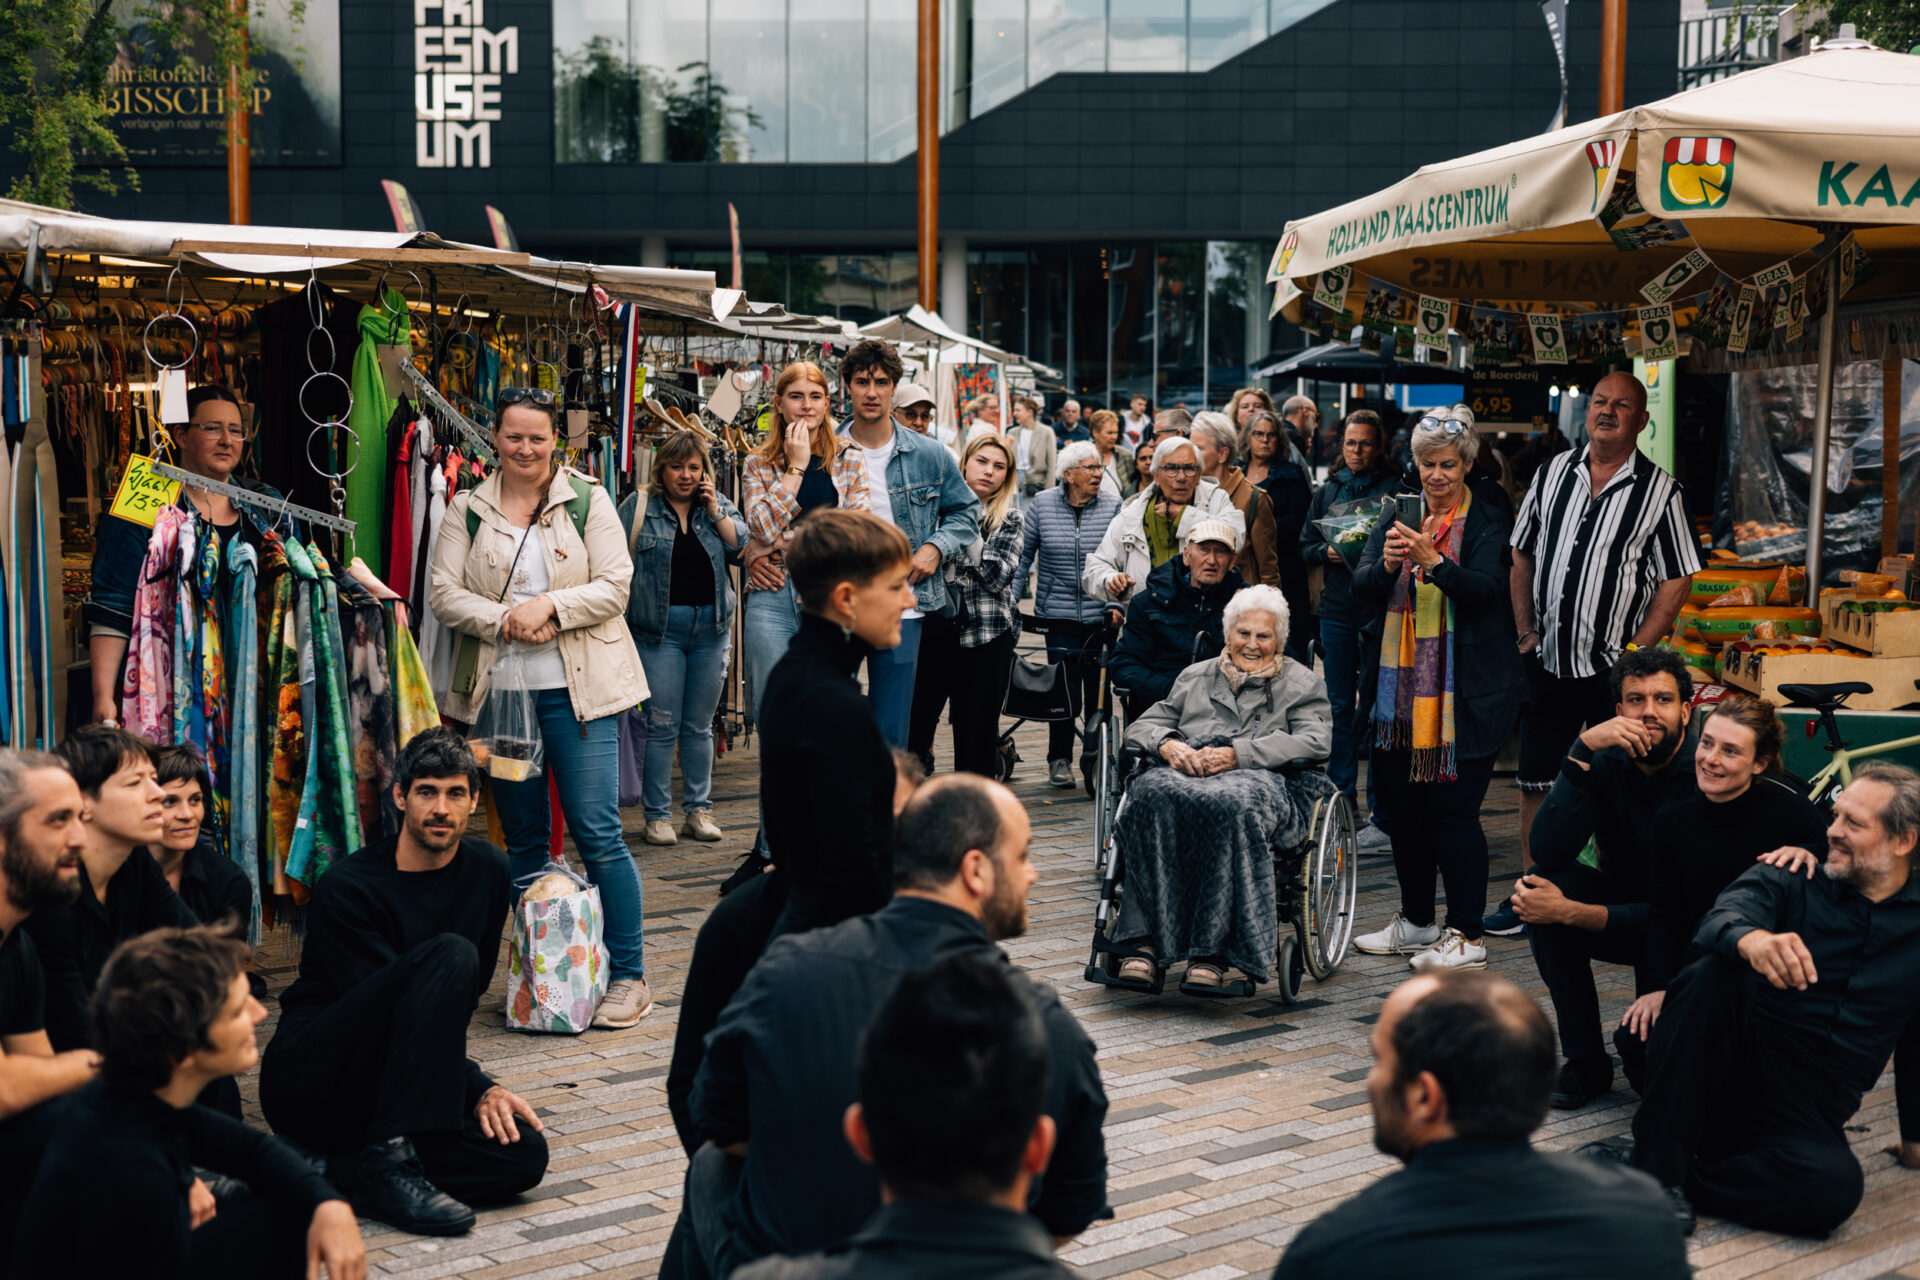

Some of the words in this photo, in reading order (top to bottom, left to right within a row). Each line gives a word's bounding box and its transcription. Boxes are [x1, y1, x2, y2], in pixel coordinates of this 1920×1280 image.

[415, 26, 518, 73] ESM
[101, 86, 272, 115] BISSCHP
[415, 73, 501, 120] USE
[120, 118, 175, 131] verlangen
[177, 119, 201, 129] naar
[416, 121, 491, 168] UM
[1325, 209, 1390, 259] HOLLAND
[1391, 183, 1510, 239] KAASCENTRUM
[1757, 264, 1789, 287] GRAS
[1316, 289, 1343, 310] KAAS
[1421, 298, 1449, 313] GRAS
[1530, 315, 1558, 326] GRAS
[1641, 306, 1671, 320] GRAS
[1418, 333, 1447, 350] KAAS
[1537, 350, 1566, 362] KAAS
[1645, 344, 1676, 360] KAAS
[1472, 370, 1487, 380] de
[1489, 370, 1539, 382] Boerderij
[1472, 396, 1512, 416] 6,95
[1698, 583, 1737, 593] GRASKA
